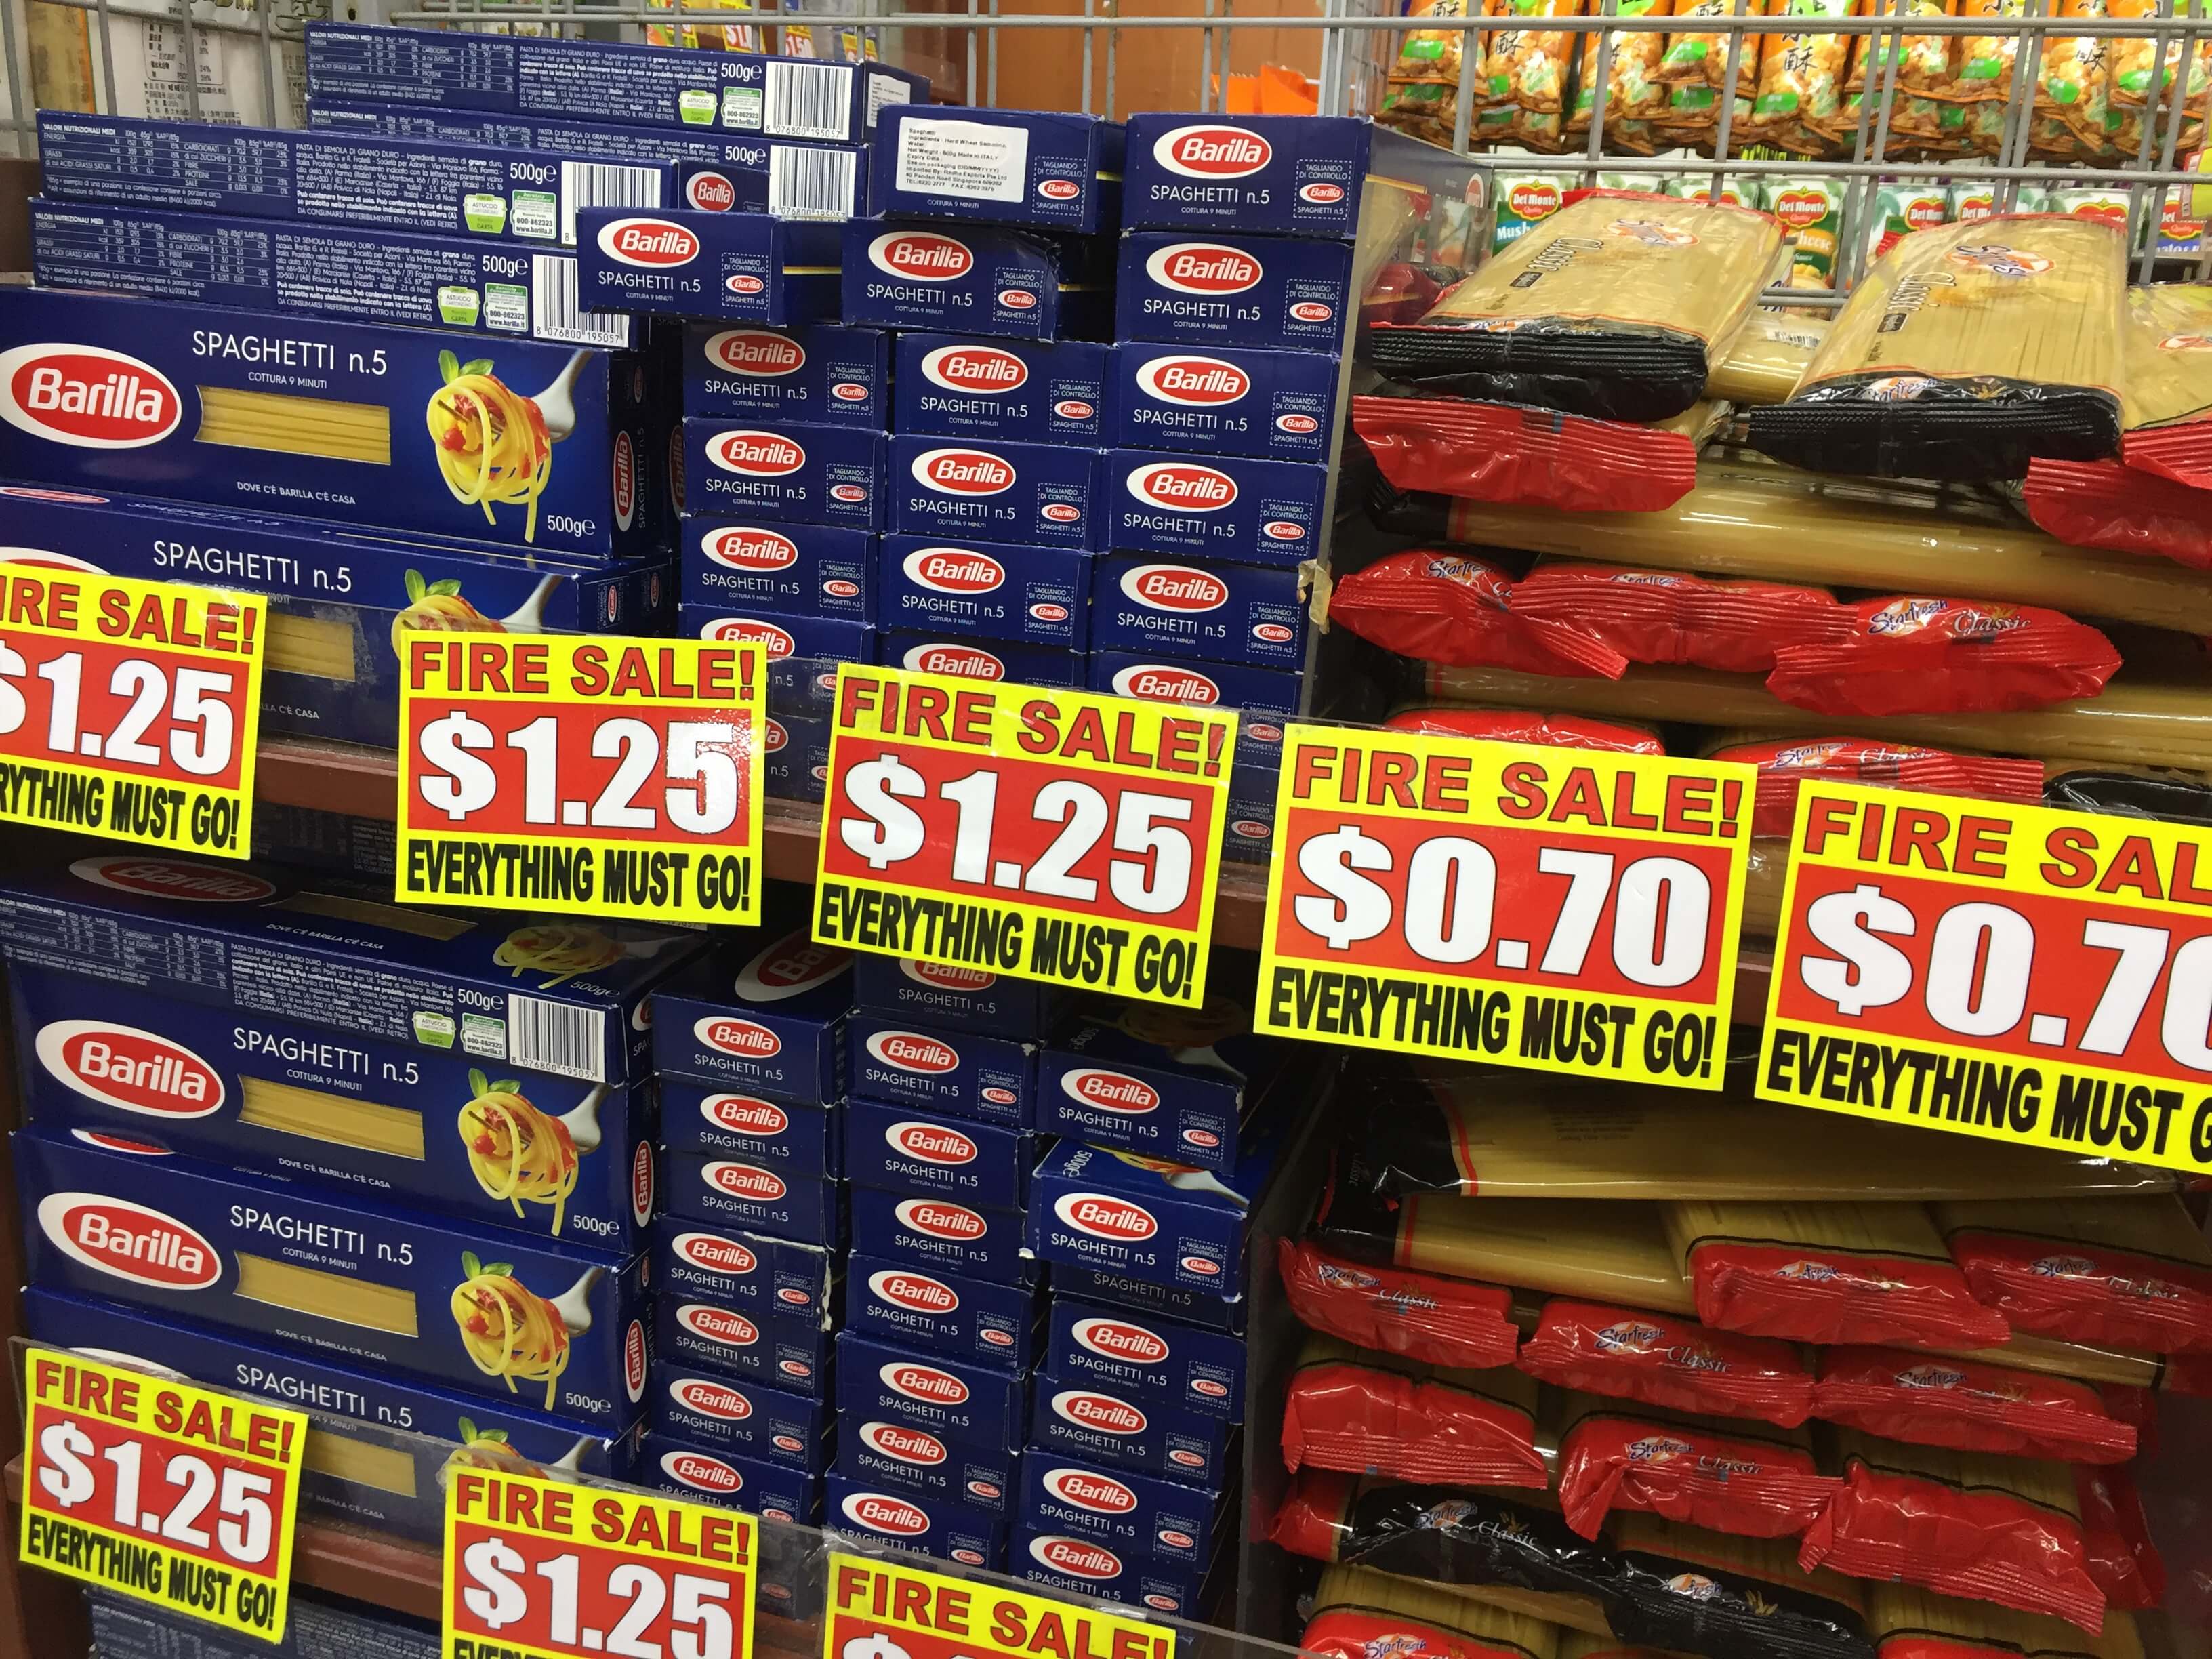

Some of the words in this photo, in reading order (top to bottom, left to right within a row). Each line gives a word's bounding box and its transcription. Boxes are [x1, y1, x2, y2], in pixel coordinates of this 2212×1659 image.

[776, 126, 806, 136] 076800
[811, 127, 840, 137] 195057
[296, 143, 314, 152] PASTA
[323, 146, 347, 155] SEMOLA
[357, 148, 379, 157] GRANO
[1044, 161, 1078, 169] TAGLIANDO
[1179, 138, 1262, 166] Barilla
[1046, 169, 1082, 177] CONTROLLO
[1151, 185, 1238, 202] SPAGHETTI
[1247, 190, 1269, 204] n.5
[1513, 194, 1527, 205] Del
[1528, 194, 1556, 206] Monte
[1780, 201, 1795, 213] Del
[1796, 202, 1826, 213] Monte
[621, 231, 691, 256] Barilla
[1798, 232, 1832, 249] heese
[893, 243, 966, 270] Barilla
[599, 271, 673, 289] SPAGHETTI
[681, 279, 700, 292] n.5
[867, 284, 945, 304] SPAGHETTI
[953, 293, 972, 306] n.5
[193, 331, 333, 369] SPAGHETTI
[350, 350, 386, 375] n.5
[249, 372, 287, 384] COTTURA
[298, 377, 327, 388] MINUTI
[951, 358, 1020, 384] Barilla
[26, 365, 165, 424] Barilla
[921, 397, 999, 415] SPAGHETTI
[1008, 405, 1027, 417] n.5
[730, 442, 798, 469] Barilla
[237, 482, 261, 492] DOVE
[279, 487, 314, 499] BARILLA
[332, 494, 355, 504] CASA
[614, 436, 632, 527] Barilla
[706, 479, 779, 497] SPAGHETTI
[787, 487, 806, 499] n.5
[1150, 476, 1230, 504] Barilla
[1124, 514, 1206, 533] SPAGHETTI
[1214, 524, 1235, 537] n.5
[154, 541, 298, 584] SPAGHETTI
[314, 567, 351, 592] n.5
[926, 557, 998, 587] Barilla
[97, 590, 256, 654] SALE!
[902, 595, 977, 615] SPAGHETTI
[985, 606, 1004, 618] n.5
[1870, 599, 1948, 637] Starfresh
[1952, 609, 2032, 633] Classic
[411, 642, 548, 694] FIRE
[571, 645, 754, 700] SALE!
[840, 676, 996, 746] FIRE
[1017, 700, 1226, 777] SALE!
[418, 710, 740, 836] $1.25
[1293, 744, 1472, 813] FIRE
[1498, 762, 1742, 838] SALE!
[111, 781, 185, 840] MUST
[192, 794, 239, 850] GO!
[840, 752, 1193, 914] $1.25
[1803, 796, 2012, 878] FIRE
[408, 840, 593, 901] EVERYTHING
[603, 850, 689, 907] MUST
[697, 855, 750, 911] GO!
[1294, 825, 1714, 988] $0.70
[819, 883, 1023, 969] EVERYTHING
[1030, 918, 1129, 986] MUST
[1135, 935, 1197, 999] GO!
[1269, 966, 1510, 1053] EVERYTHING
[1520, 996, 1635, 1068] MUST
[1644, 1010, 1716, 1078] GO!
[714, 1026, 775, 1051] Barilla
[234, 1028, 368, 1074] SPAGHETTI
[384, 1063, 418, 1084] n.5
[695, 1054, 759, 1075] SPAGHETTI
[766, 1070, 782, 1080] n.5
[78, 1044, 209, 1103] Barilla
[287, 1069, 323, 1083] COTTURA
[334, 1079, 361, 1090] MINUTI
[1767, 1029, 2042, 1132] EVERYTHING
[2051, 1075, 2183, 1155] MUST
[907, 1130, 970, 1159] Barilla
[279, 1158, 301, 1168] DOVE
[319, 1167, 351, 1179] BARILLA
[369, 1179, 390, 1188] CASA
[886, 1160, 953, 1182] SPAGHETTI
[960, 1176, 977, 1186] n.5
[1077, 1203, 1151, 1232] Barilla
[77, 1214, 206, 1276] Barilla
[230, 1206, 363, 1256] SPAGHETTI
[379, 1244, 412, 1265] n.5
[1052, 1233, 1128, 1259] SPAGHETTI
[1135, 1254, 1155, 1265] n.5
[1593, 1323, 1666, 1349] Starfresh
[1666, 1345, 1732, 1373] Classic
[37, 1359, 140, 1422] FIRE
[155, 1391, 294, 1463] SALE!
[237, 1365, 364, 1415] SPAGHETTI
[375, 1406, 412, 1429] n.5
[1072, 1401, 1139, 1429] Barilla
[1050, 1425, 1121, 1450] SPAGHETTI
[1127, 1446, 1145, 1456] n.5
[37, 1420, 272, 1564] $1.25
[457, 1474, 573, 1534] FIRE
[592, 1499, 750, 1565] SALE!
[28, 1514, 162, 1593] EVERYTHING
[169, 1557, 231, 1614] MUST
[237, 1579, 276, 1627] GO!
[463, 1537, 733, 1659] $1.25
[837, 1565, 971, 1635] FIRE
